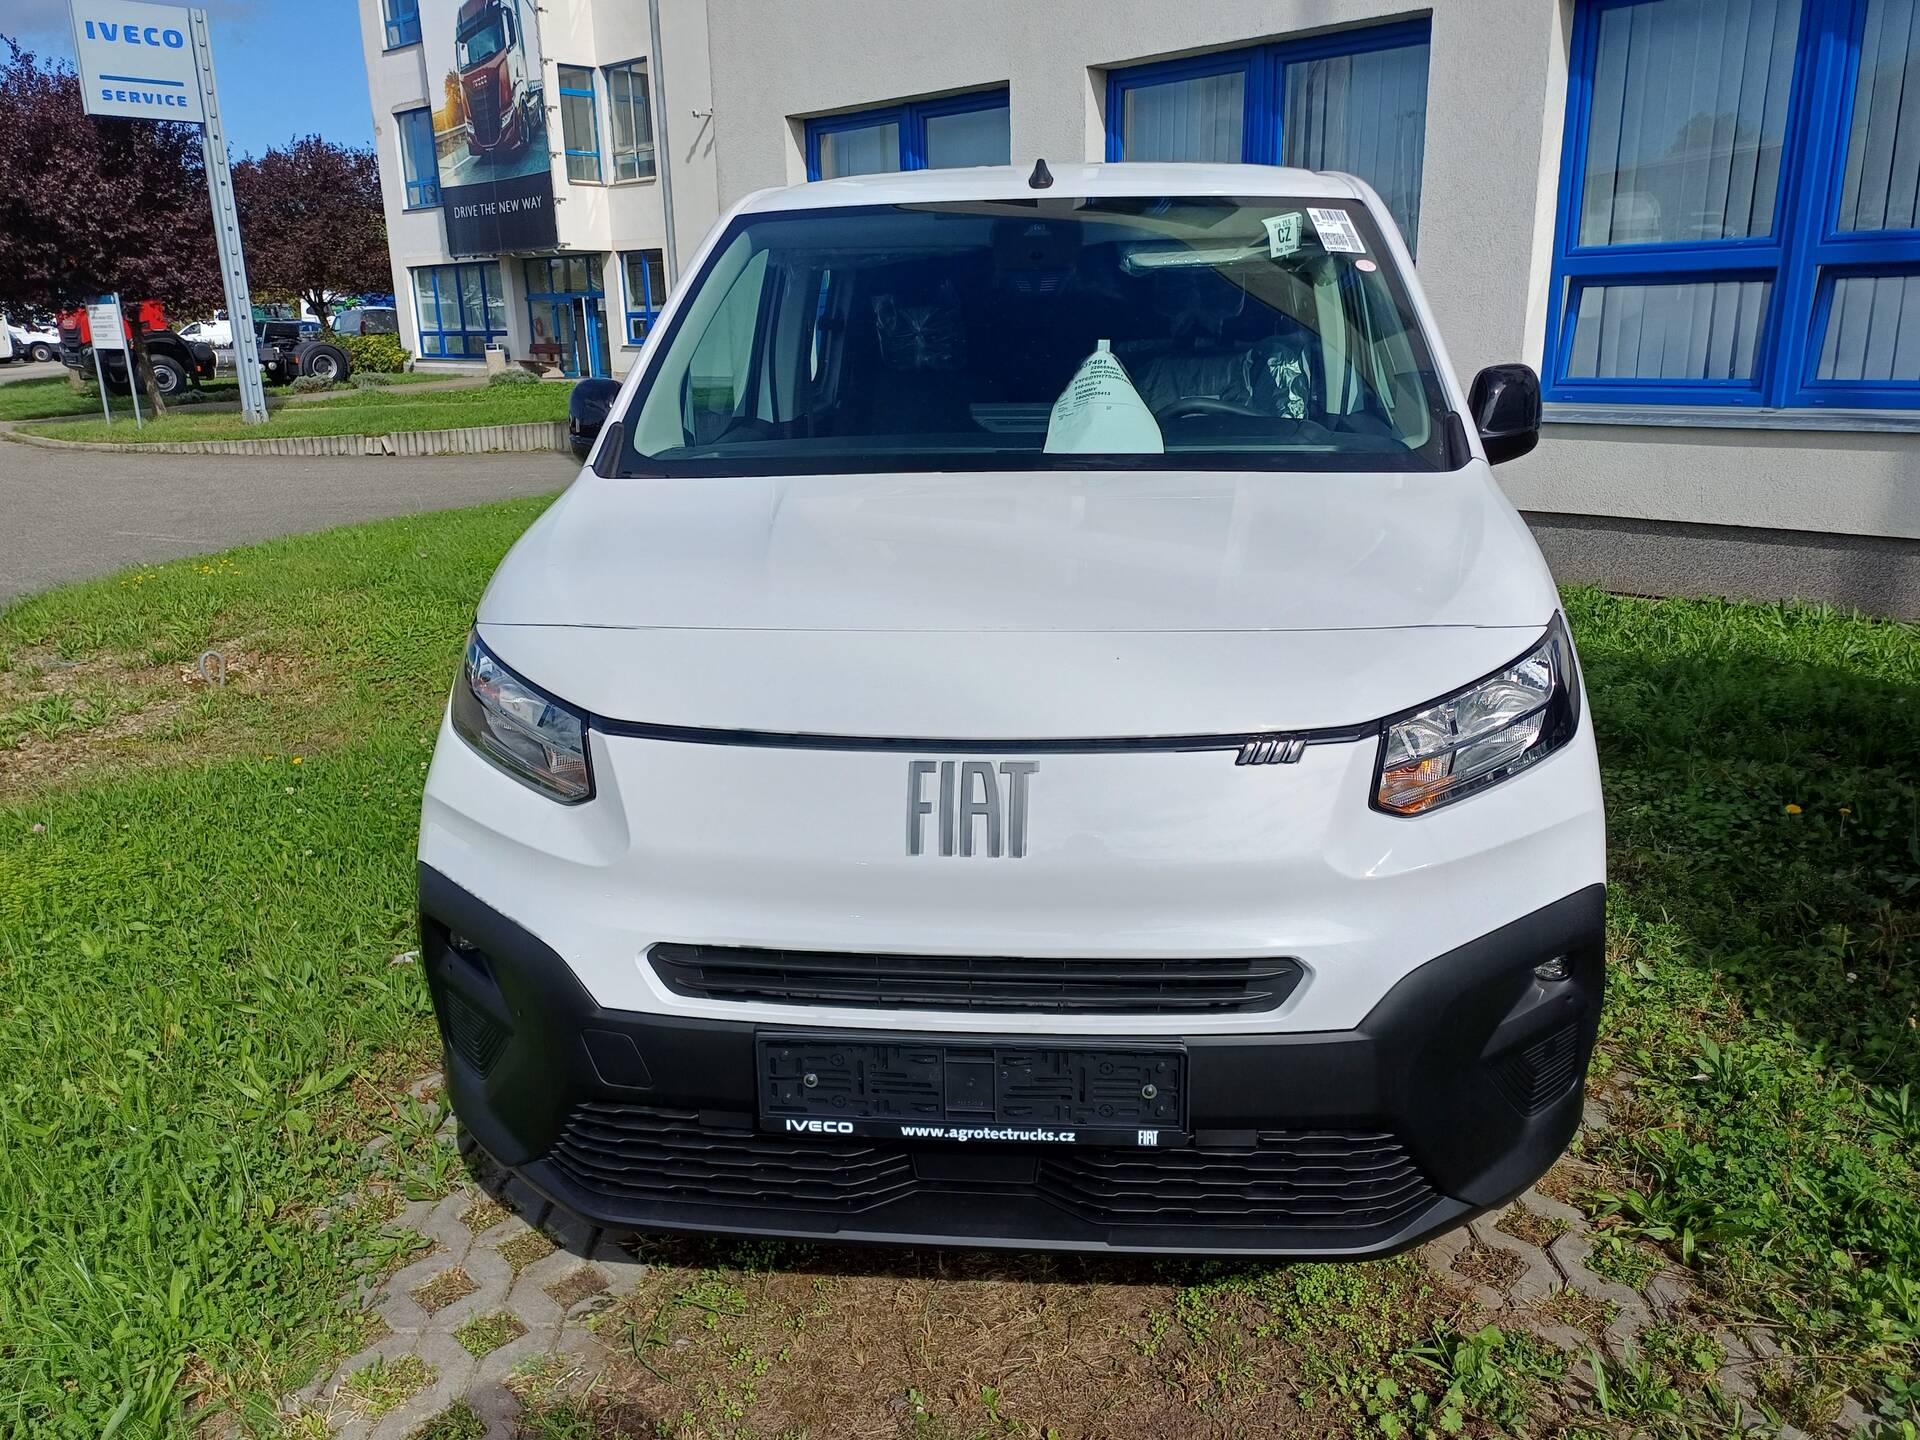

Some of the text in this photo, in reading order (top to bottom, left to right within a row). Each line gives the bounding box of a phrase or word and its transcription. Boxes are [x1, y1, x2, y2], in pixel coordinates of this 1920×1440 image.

[85, 20, 184, 49] IVECO
[101, 89, 188, 107] SERVICE
[453, 195, 543, 219] DRIVE THE NEW WAY
[1278, 226, 1291, 243] CZ
[906, 760, 1040, 858] FIAT
[785, 1119, 1160, 1147] IVECO www.agrotectrucks.cz FIAT
